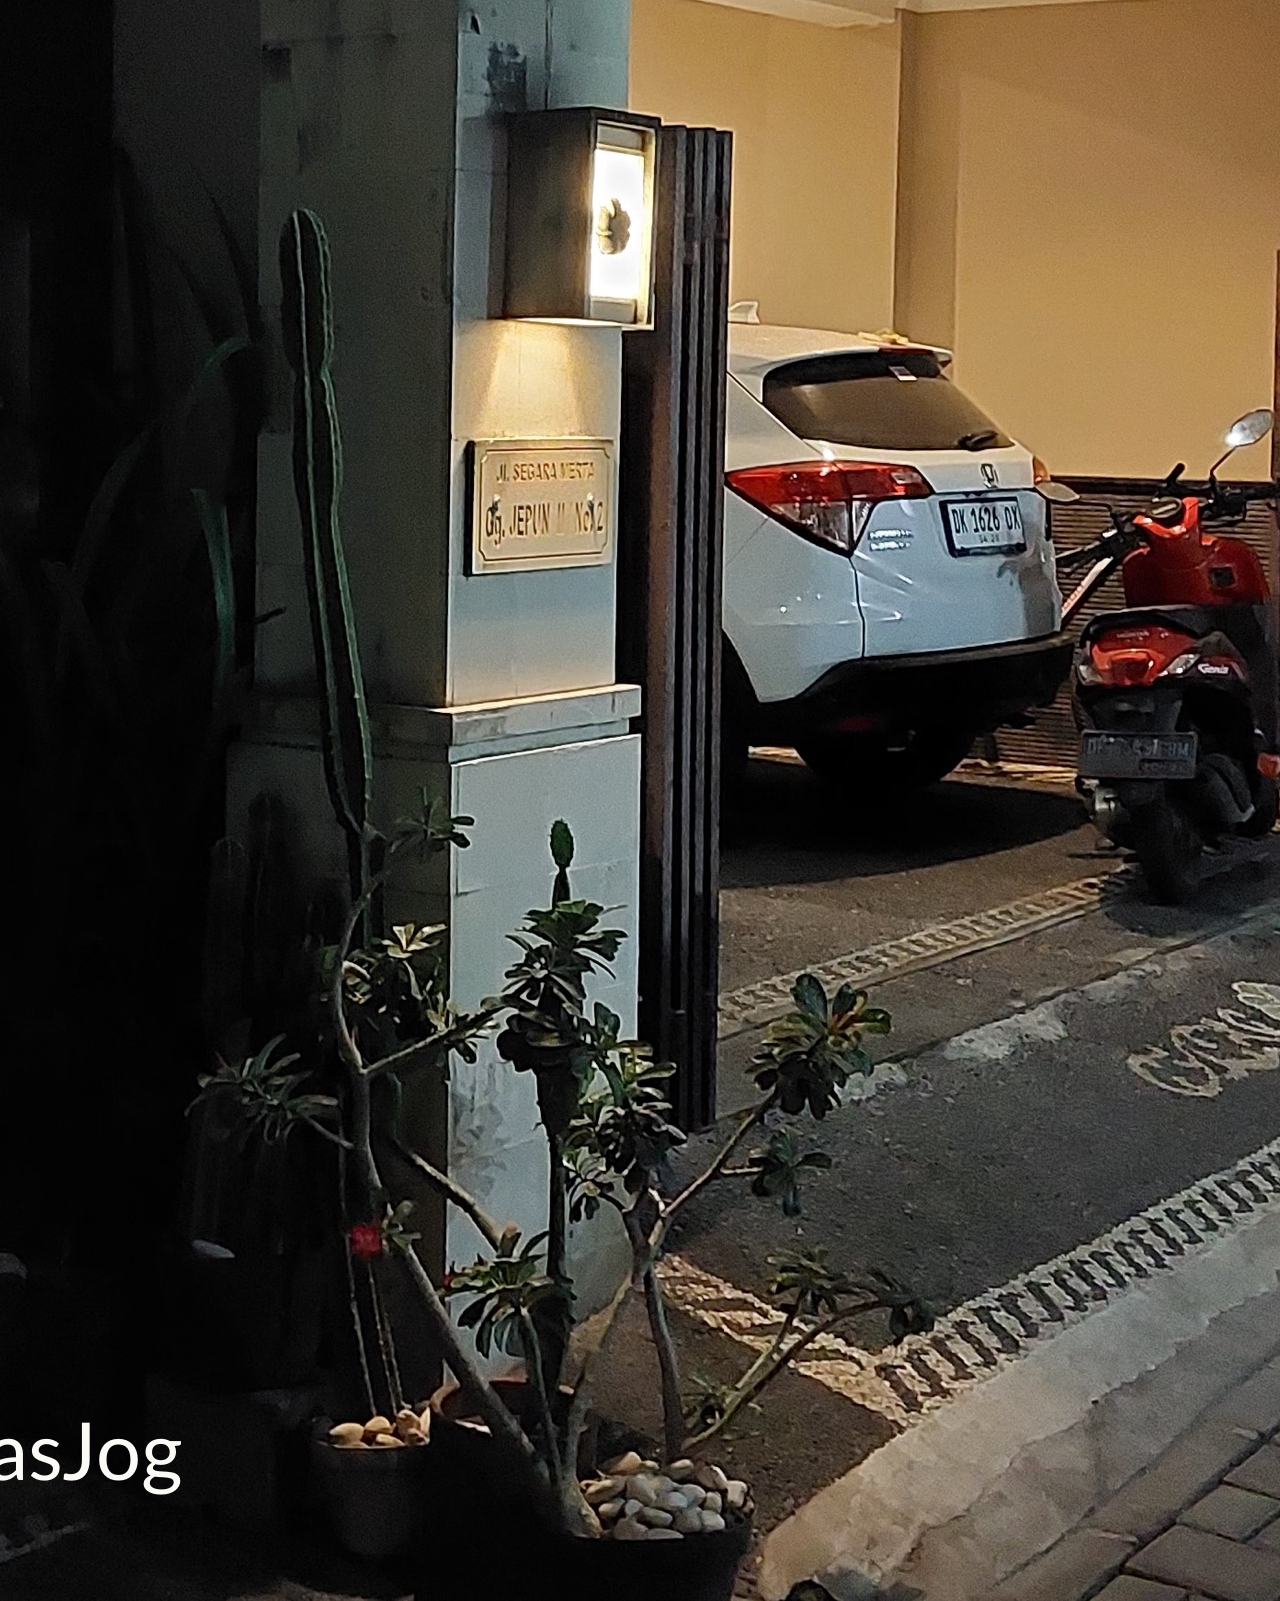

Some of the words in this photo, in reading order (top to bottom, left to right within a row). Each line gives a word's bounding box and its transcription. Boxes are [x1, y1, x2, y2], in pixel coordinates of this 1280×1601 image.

[513, 462, 557, 482] SEGARA
[509, 502, 550, 536] JEPUN
[951, 507, 969, 534] DK
[970, 506, 1001, 533] 1626
